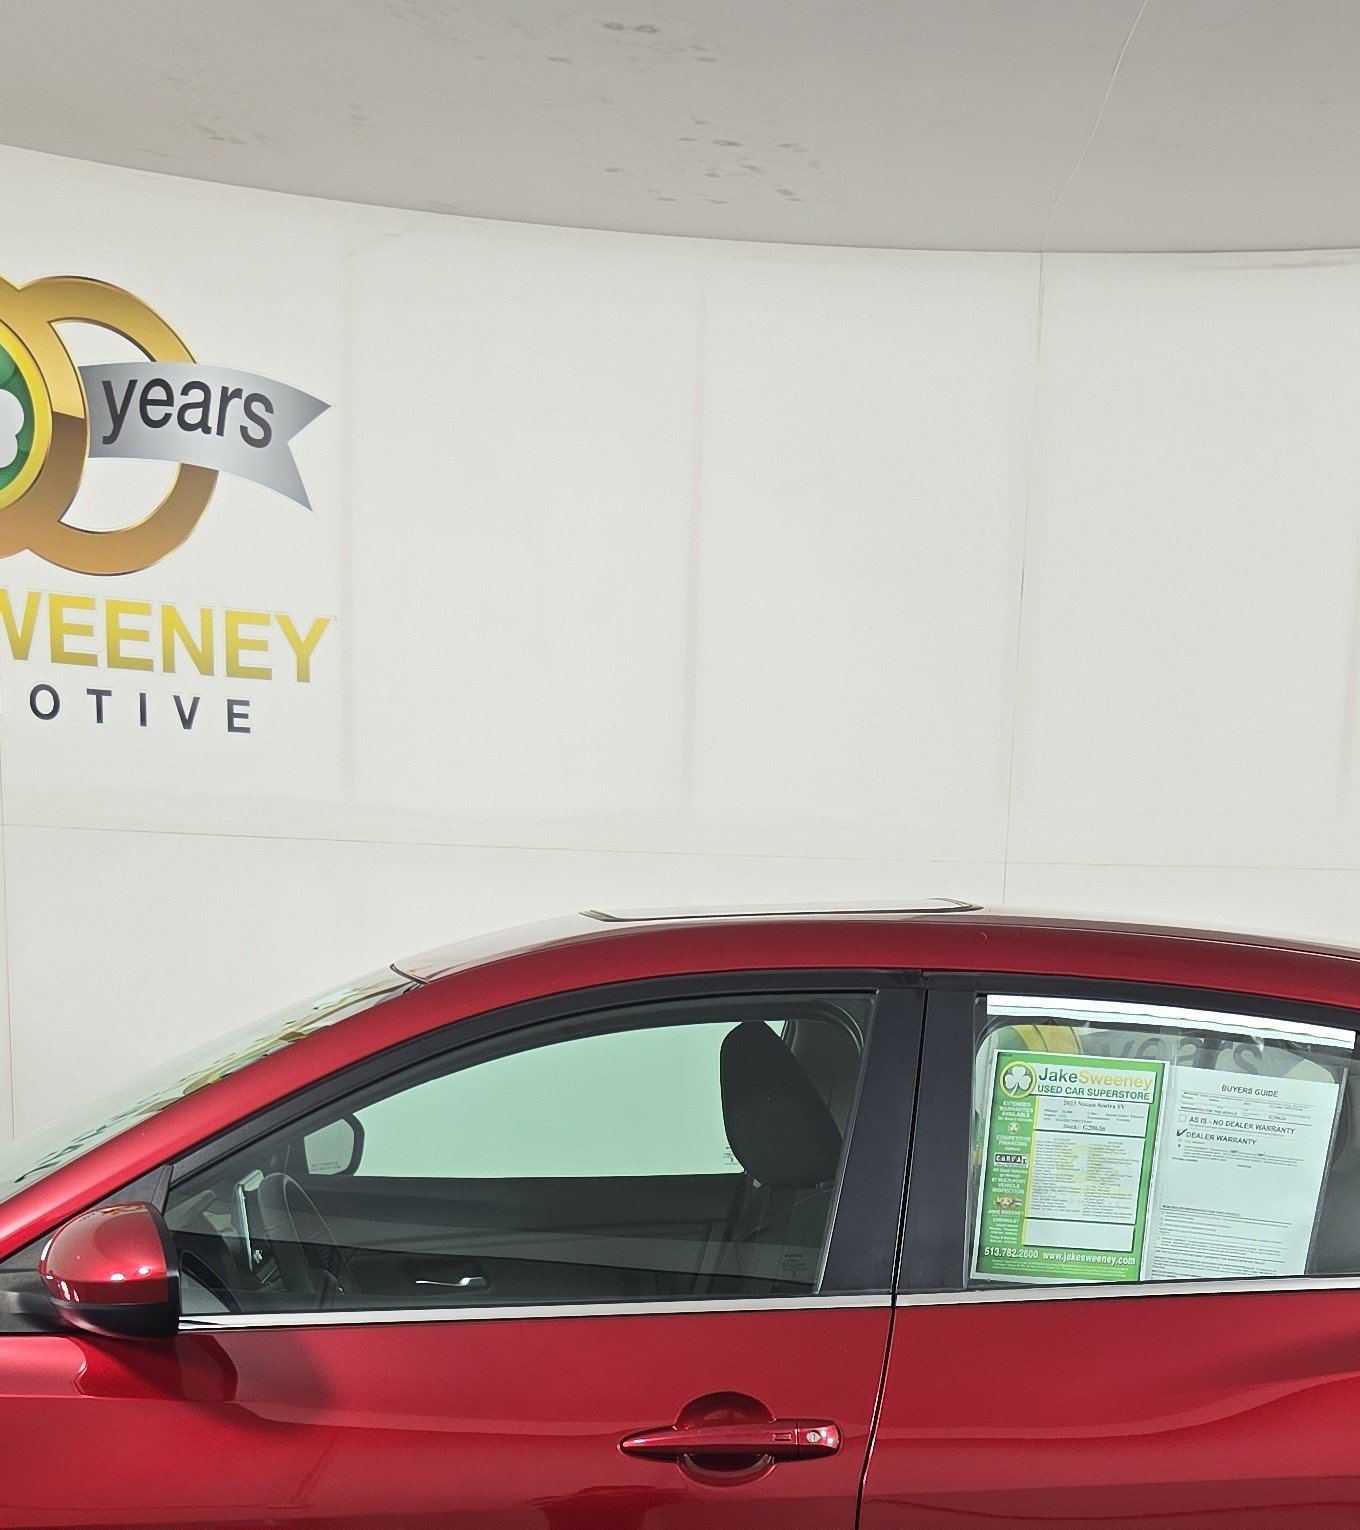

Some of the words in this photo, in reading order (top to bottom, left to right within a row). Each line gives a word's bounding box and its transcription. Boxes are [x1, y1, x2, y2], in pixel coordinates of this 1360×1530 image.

[102, 375, 275, 448] years
[1037, 1085, 1063, 1094] USED
[1065, 1087, 1085, 1096] CAR
[1086, 1088, 1151, 1101] SUPERSTORE
[1221, 1085, 1253, 1095] BUYERS
[1255, 1089, 1279, 1098] GUIDE
[1189, 1116, 1199, 1124] AS
[1200, 1117, 1208, 1125] IS
[1213, 1119, 1223, 1127] NO
[1225, 1120, 1254, 1130] DEALER
[1255, 1124, 1296, 1135] WARRANTY
[1186, 1131, 1215, 1141] DEALER
[1216, 1135, 1258, 1145] WARRANTY
